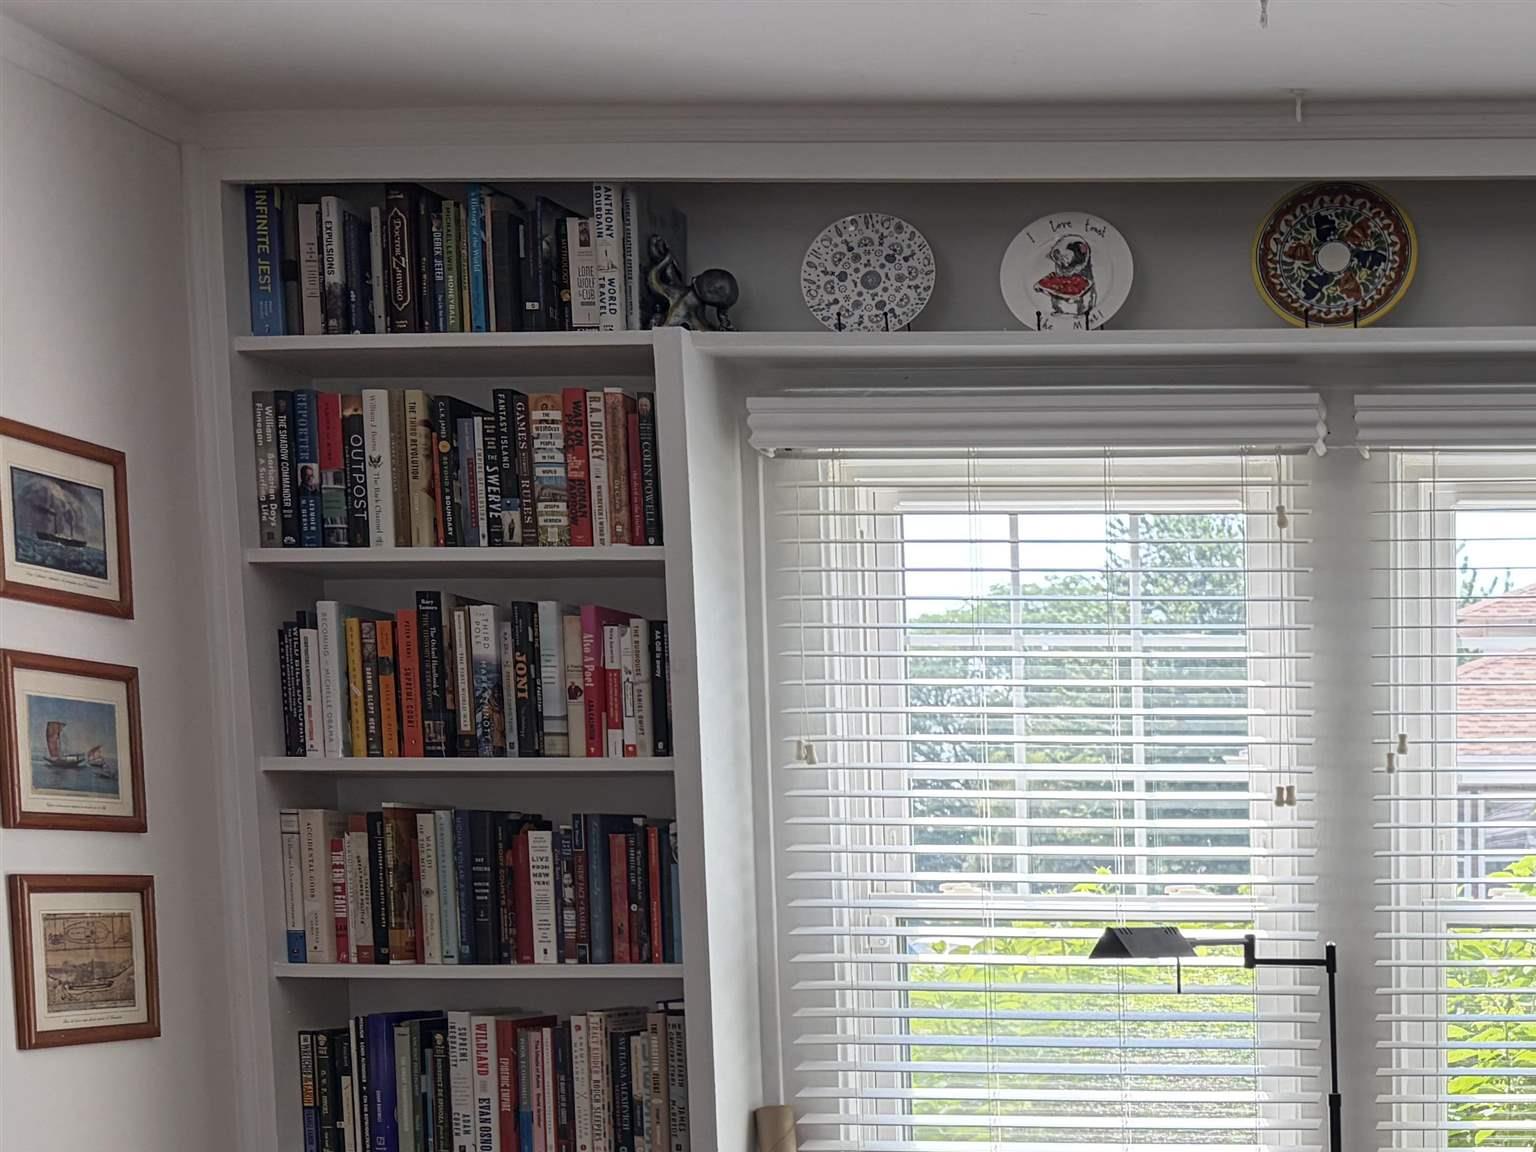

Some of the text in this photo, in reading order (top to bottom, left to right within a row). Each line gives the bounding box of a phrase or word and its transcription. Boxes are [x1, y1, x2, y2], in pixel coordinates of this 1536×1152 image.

[593, 186, 604, 239] BOURDAIN
[603, 187, 615, 239] ANTHONY
[255, 190, 272, 292] INFINITE JEST
[324, 220, 337, 275] EXPULSIONS
[431, 232, 443, 256] DEREK
[444, 207, 457, 326] MICHAEL LEWIS MONEYBALL
[597, 277, 607, 317] TRAVEL
[606, 278, 618, 315] WORLD
[254, 403, 265, 447] Finnegan
[264, 406, 275, 443] William
[295, 394, 311, 460] REPORTER
[407, 402, 416, 414] THE
[496, 394, 510, 469] FANTASY ISLAND
[277, 416, 292, 507] THE SHADOW COMMANDER
[409, 439, 420, 480] REVOLUTION
[515, 402, 533, 524] GAMES RULES
[590, 421, 605, 461] DICKEY
[349, 434, 368, 520] OUTPOST
[485, 465, 501, 518] SWERVE
[640, 442, 656, 524] COLIN POWELL
[268, 503, 279, 527] Days
[582, 633, 594, 653] Also
[320, 613, 330, 657] BECOMING
[326, 713, 337, 743] OBAMA
[514, 652, 528, 700] JONI
[583, 665, 597, 687] Poet
[331, 851, 344, 864] THE
[333, 868, 346, 883] END
[335, 895, 347, 917] FAITH
[474, 1023, 490, 1076] WILDLAND
[499, 1058, 512, 1112] EPIDEMIC EMPIRE
[478, 1097, 491, 1123] EVAN
